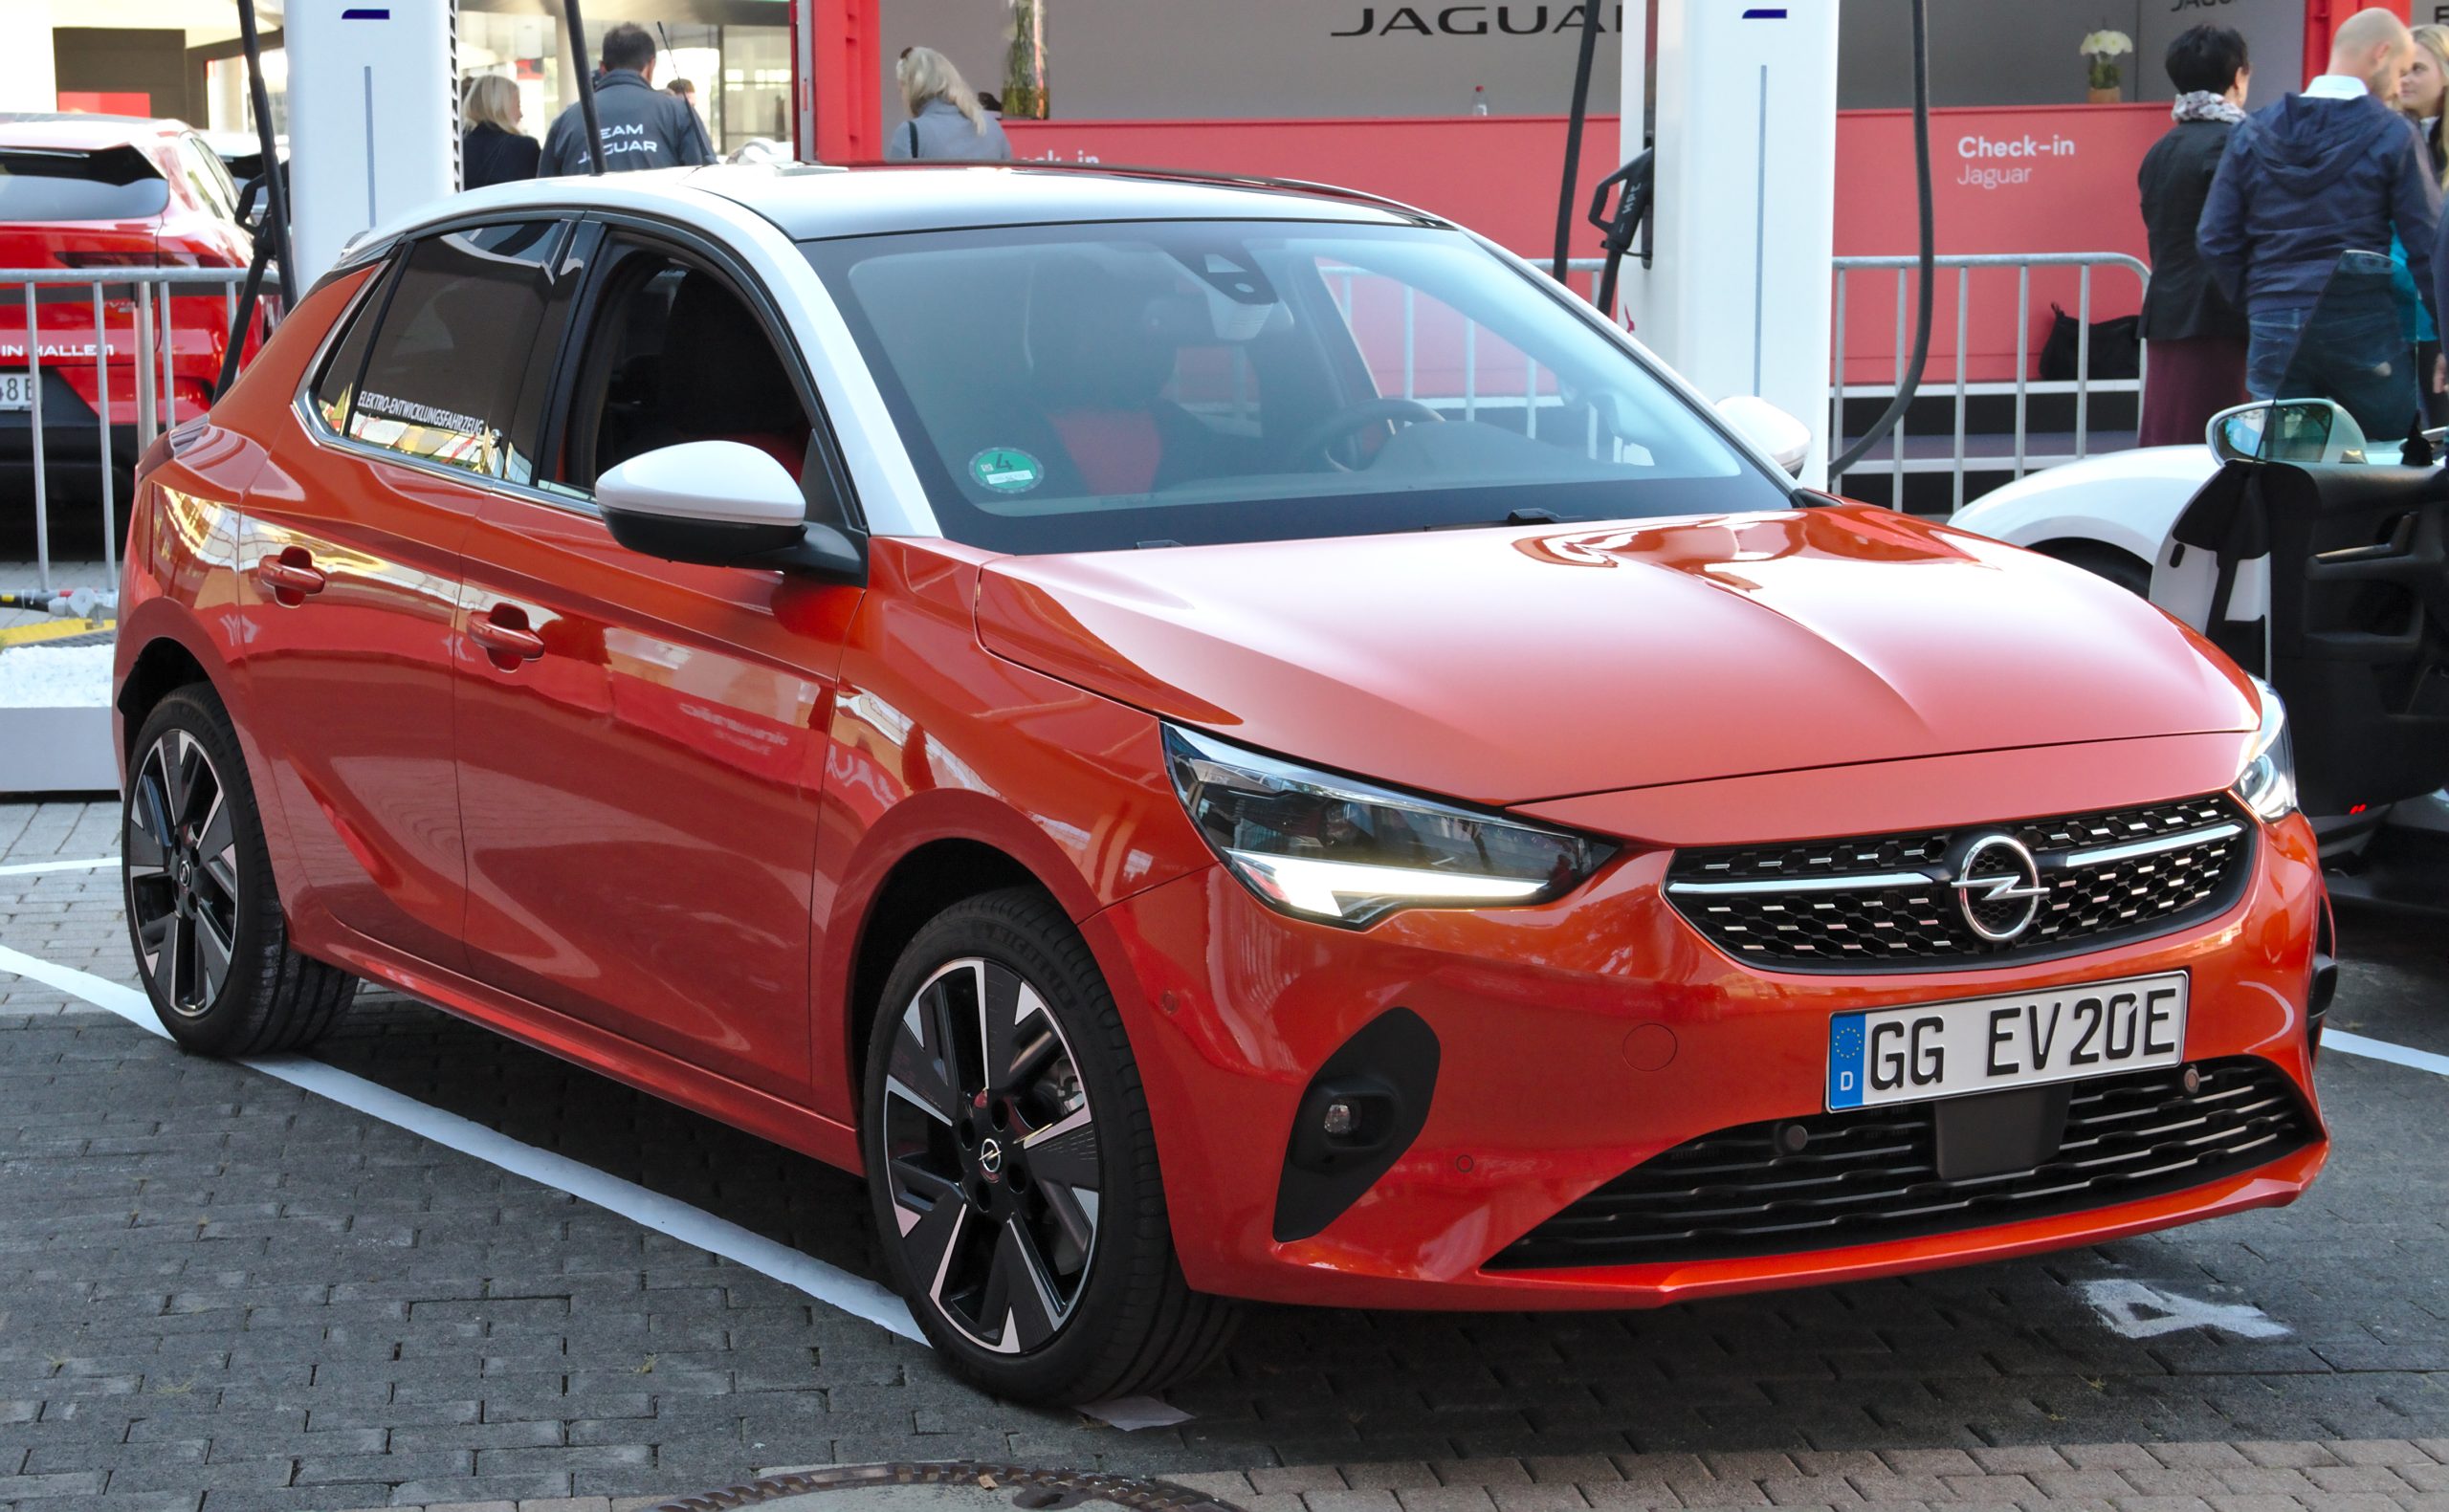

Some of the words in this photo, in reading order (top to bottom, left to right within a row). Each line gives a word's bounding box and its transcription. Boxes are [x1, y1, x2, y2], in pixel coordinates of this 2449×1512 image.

[1331, 6, 1622, 36] JAGUA
[600, 123, 643, 140] EAM
[577, 140, 658, 164] JGUAR
[1957, 134, 2075, 158] Check-in
[1956, 164, 2032, 189] Jaguar
[357, 390, 485, 435] ELEKTRO-ENTWICKLUNGSFAHRZEUG
[1870, 1016, 1945, 1091] GG
[1840, 1070, 1854, 1091] D
